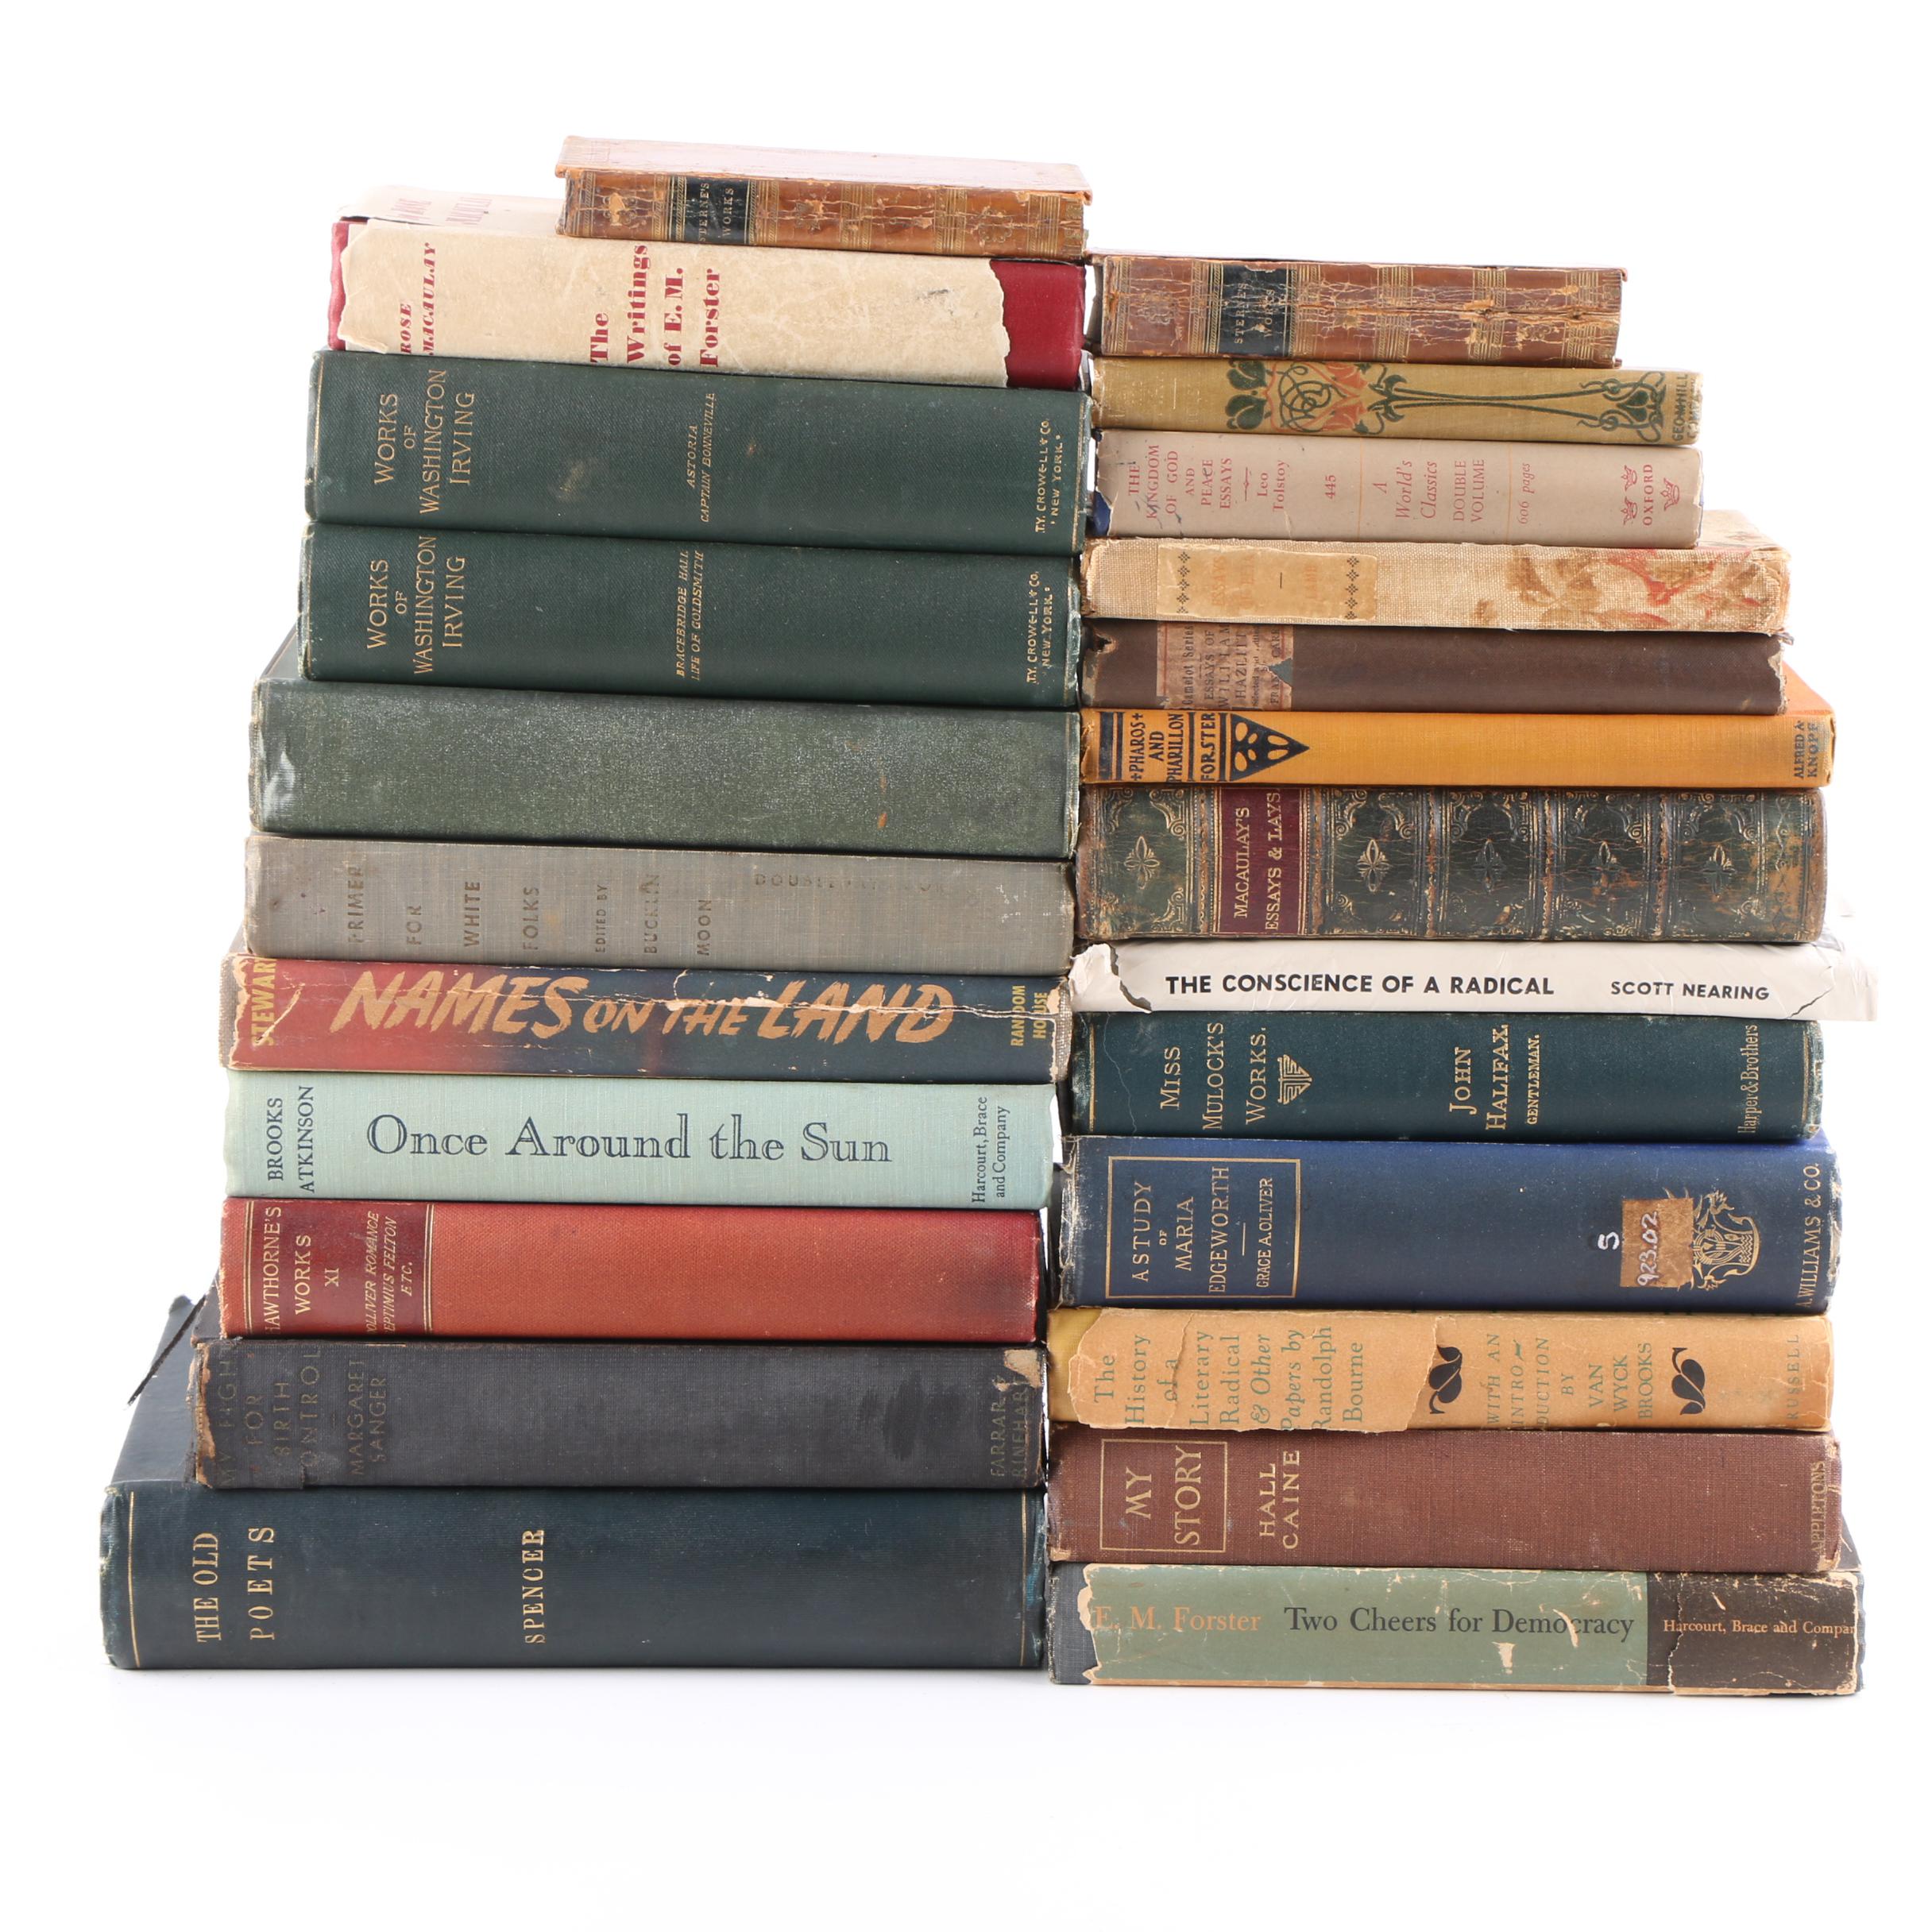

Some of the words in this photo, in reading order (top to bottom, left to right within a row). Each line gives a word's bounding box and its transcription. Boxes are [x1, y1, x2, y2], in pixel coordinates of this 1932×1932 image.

[698, 183, 709, 242] STERNE'S
[722, 187, 734, 237] WORKS
[400, 303, 412, 354] ROSE
[627, 245, 651, 363] Writings
[700, 269, 720, 367] Forster
[591, 312, 609, 363] The
[667, 343, 682, 366] of
[375, 394, 397, 484] WORKS
[404, 426, 416, 449] OF
[419, 369, 446, 514] WASHINGTON
[450, 392, 474, 485] IRVING
[686, 424, 697, 488] ASTORIA
[703, 393, 715, 467] BONNEVILLE
[1129, 466, 1141, 495] THE
[1146, 445, 1159, 519] KINGDOM
[1167, 450, 1179, 483] GOD
[1185, 468, 1196, 496] AND
[1201, 459, 1213, 506] PEACE
[1220, 457, 1232, 509] ESSAYS
[1257, 472, 1268, 497] Leo
[1273, 460, 1289, 512] Tolstoy
[1325, 474, 1336, 500] 445
[1372, 481, 1387, 493] A
[1396, 459, 1412, 520] World's
[1420, 461, 1437, 520] Classics
[1453, 460, 1466, 522] DOUBLE
[1471, 458, 1485, 523] VOLUME
[1521, 462, 1536, 495] pages
[1643, 464, 1653, 526] OXFORD
[701, 469, 712, 523] CAPTAIN
[1050, 488, 1059, 517] NEW
[1166, 494, 1177, 515] OF
[1517, 500, 1528, 525] 606
[679, 551, 689, 583] HALL
[692, 551, 704, 631] GOLDSMITH
[367, 559, 388, 649] WORKS
[396, 591, 408, 615] OF
[414, 536, 437, 674] WASHINGTON
[442, 556, 466, 648] IRVING
[676, 587, 687, 678] BRACEBRIDGE
[1041, 639, 1050, 667] NEW
[1181, 626, 1194, 658] Series
[1204, 630, 1215, 647] OF
[690, 656, 701, 682] LIFE
[1181, 665, 1194, 705] Camelot
[1204, 654, 1215, 700] ESSAYS
[1149, 730, 1165, 762] AND
[1166, 713, 1184, 782] PHARILLON
[1201, 713, 1216, 782] FORSTER
[1793, 734, 1805, 779] ALFRED
[1806, 722, 1818, 778] KNOPF
[1235, 806, 1250, 919] MACAULAY'S
[1268, 848, 1282, 860] &
[349, 864, 364, 944] PRIMER
[464, 881, 481, 947] WHITE
[523, 886, 539, 950] FOLKS
[597, 884, 607, 903] BY
[1265, 868, 1282, 930] ESSAYS
[407, 906, 422, 946] FOR
[595, 908, 606, 953] EDITED
[697, 899, 712, 956] MOON
[329, 970, 589, 1039] NAMES
[582, 998, 655, 1034] ON
[662, 999, 751, 1036] THE
[755, 979, 954, 1045] LAND
[1010, 985, 1025, 1046] RANDOM
[1032, 991, 1047, 1039] HOUSE
[1166, 976, 1211, 995] THE
[1222, 974, 1373, 993] CONSCIENCE
[1382, 976, 1414, 994] OF
[1424, 976, 1440, 995] A
[1451, 976, 1554, 995] RADICAL
[1611, 981, 1674, 996] SCOTT
[1682, 983, 1770, 1000] NEARING
[1203, 1022, 1223, 1130] MULOCK'S
[1450, 1047, 1478, 1115] JOHN
[267, 1097, 284, 1180] BROOKS
[298, 1086, 315, 1193] ATKINSON
[367, 1115, 488, 1156] Once
[505, 1114, 690, 1158] Around
[709, 1114, 784, 1160] the
[800, 1122, 892, 1162] Sun
[974, 1096, 988, 1135] Brace
[992, 1106, 1010, 1173] Company
[996, 1176, 1006, 1198] and
[1804, 1195, 1822, 1208] &
[365, 1211, 379, 1276] ROMANCE
[383, 1217, 397, 1270] FELTON
[1133, 1181, 1151, 1265] STUDY
[1159, 1230, 1168, 1246] OF
[1176, 1196, 1194, 1272] MARIA
[1208, 1166, 1229, 1293] EDGEWORTH
[1637, 1211, 1660, 1287] 923.02
[295, 1235, 311, 1315] WORKS
[324, 1268, 339, 1287] XI
[401, 1262, 413, 1296] ETC.
[1256, 1250, 1272, 1288] GRACE
[1250, 1334, 1270, 1397] Other
[1281, 1329, 1304, 1355] by
[1486, 1333, 1500, 1362] AN
[1094, 1355, 1115, 1404] The
[1125, 1335, 1151, 1424] History
[1157, 1379, 1177, 1403] of
[1190, 1331, 1214, 1425] Literary
[1219, 1335, 1239, 1425] Radical
[1281, 1362, 1304, 1431] Papers
[1312, 1326, 1336, 1431] Randolph
[1343, 1343, 1363, 1423] Bourne
[1487, 1374, 1500, 1424] WITH
[1535, 1337, 1550, 1425] DUCTION
[1560, 1373, 1574, 1395] BY
[1588, 1362, 1604, 1408] VAN
[1613, 1354, 1629, 1412] WYCK
[1637, 1343, 1653, 1420] BROOKS
[1786, 1335, 1799, 1420] RUSSELL
[244, 1394, 265, 1445] FOR
[272, 1381, 293, 1457] BIRTH
[346, 1359, 365, 1476] MARGARET
[369, 1377, 388, 1463] SANGER
[990, 1397, 1007, 1477] FARRAR
[1250, 1405, 1269, 1424] &
[1126, 1466, 1151, 1519] MY
[1174, 1444, 1201, 1545] STORY
[1259, 1463, 1276, 1537] HALL
[1283, 1450, 1300, 1550] CAINE
[192, 1532, 219, 1586] OLD
[248, 1526, 275, 1640] POETS
[522, 1529, 546, 1644] SPENCER
[194, 1598, 222, 1642] THE
[1094, 1605, 1120, 1629] E.
[1130, 1605, 1162, 1629] M.
[1173, 1605, 1262, 1630] Forster
[1284, 1607, 1338, 1631] Two
[1350, 1608, 1436, 1633] Cheers
[1449, 1607, 1482, 1633] for
[1492, 1609, 1635, 1644] Democracy
[1663, 1619, 1726, 1634] Harcourt,
[1732, 1619, 1768, 1634] Brace
[1773, 1620, 1798, 1634] and
